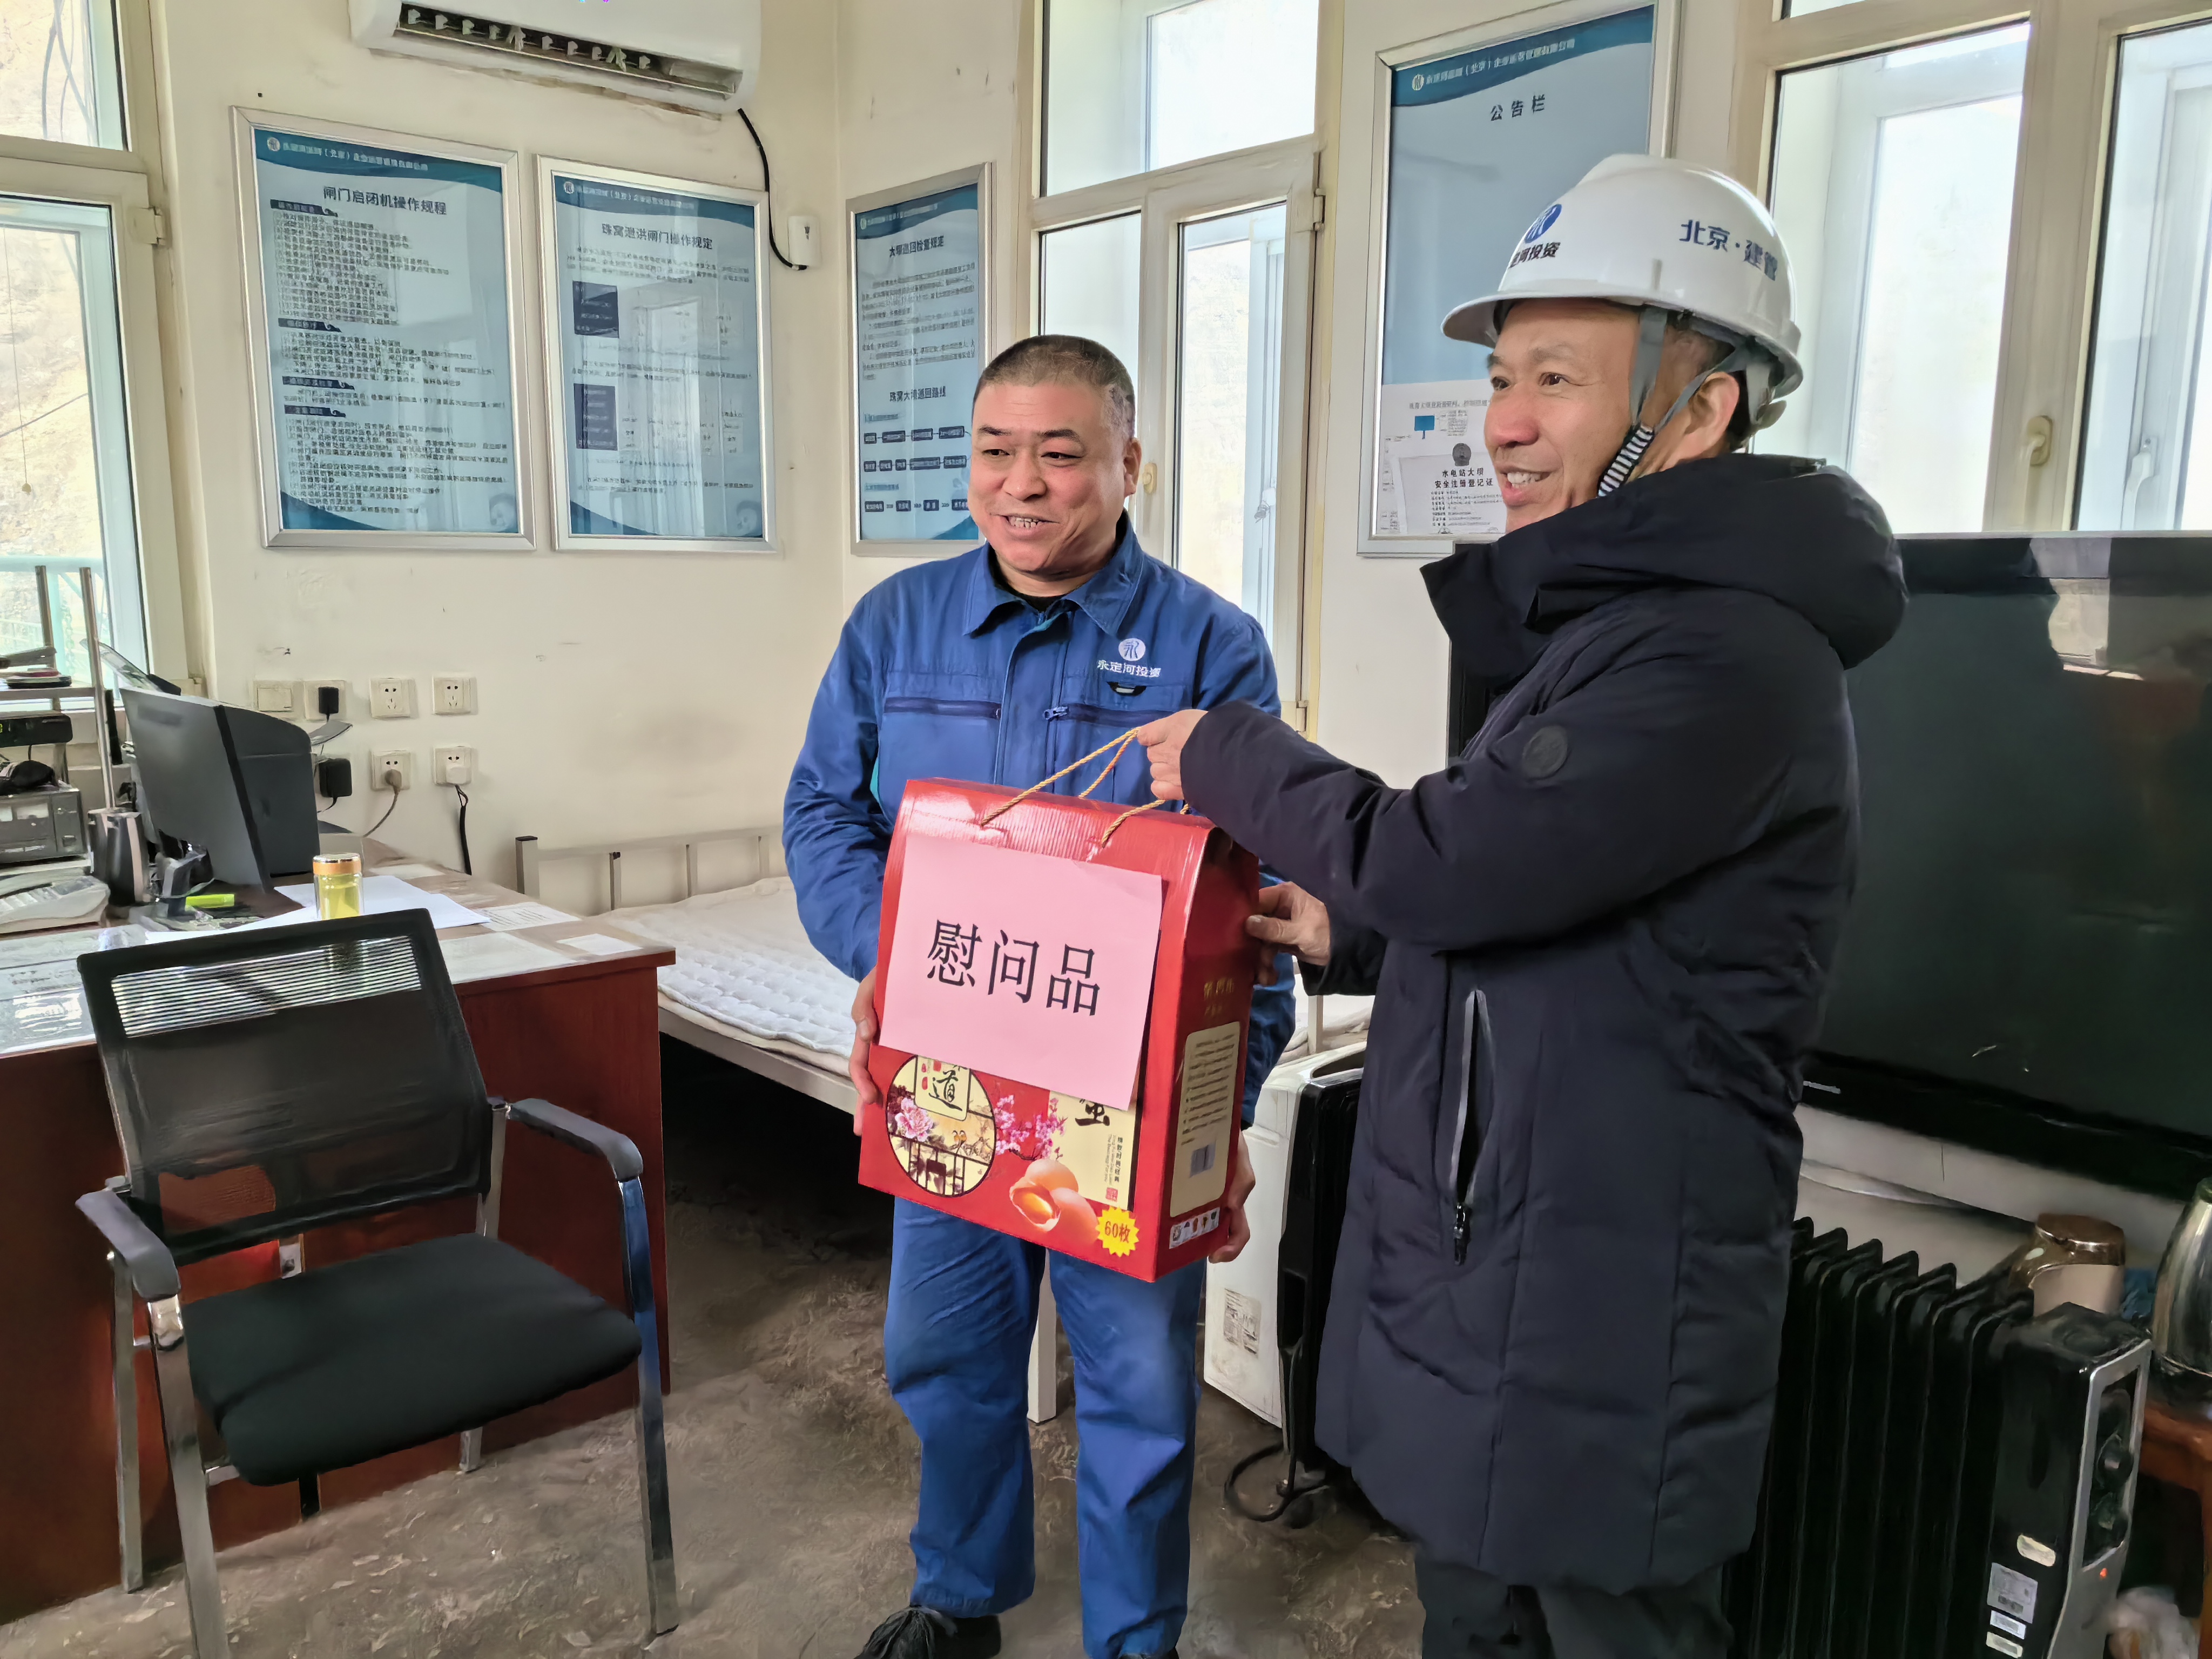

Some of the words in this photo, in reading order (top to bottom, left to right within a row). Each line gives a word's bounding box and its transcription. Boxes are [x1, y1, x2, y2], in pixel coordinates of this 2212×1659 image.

[1490, 93, 1546, 122] 公告栏
[927, 919, 1101, 1016] 慰问品
[928, 1065, 968, 1111] 道
[1105, 1220, 1130, 1244] 60枚
